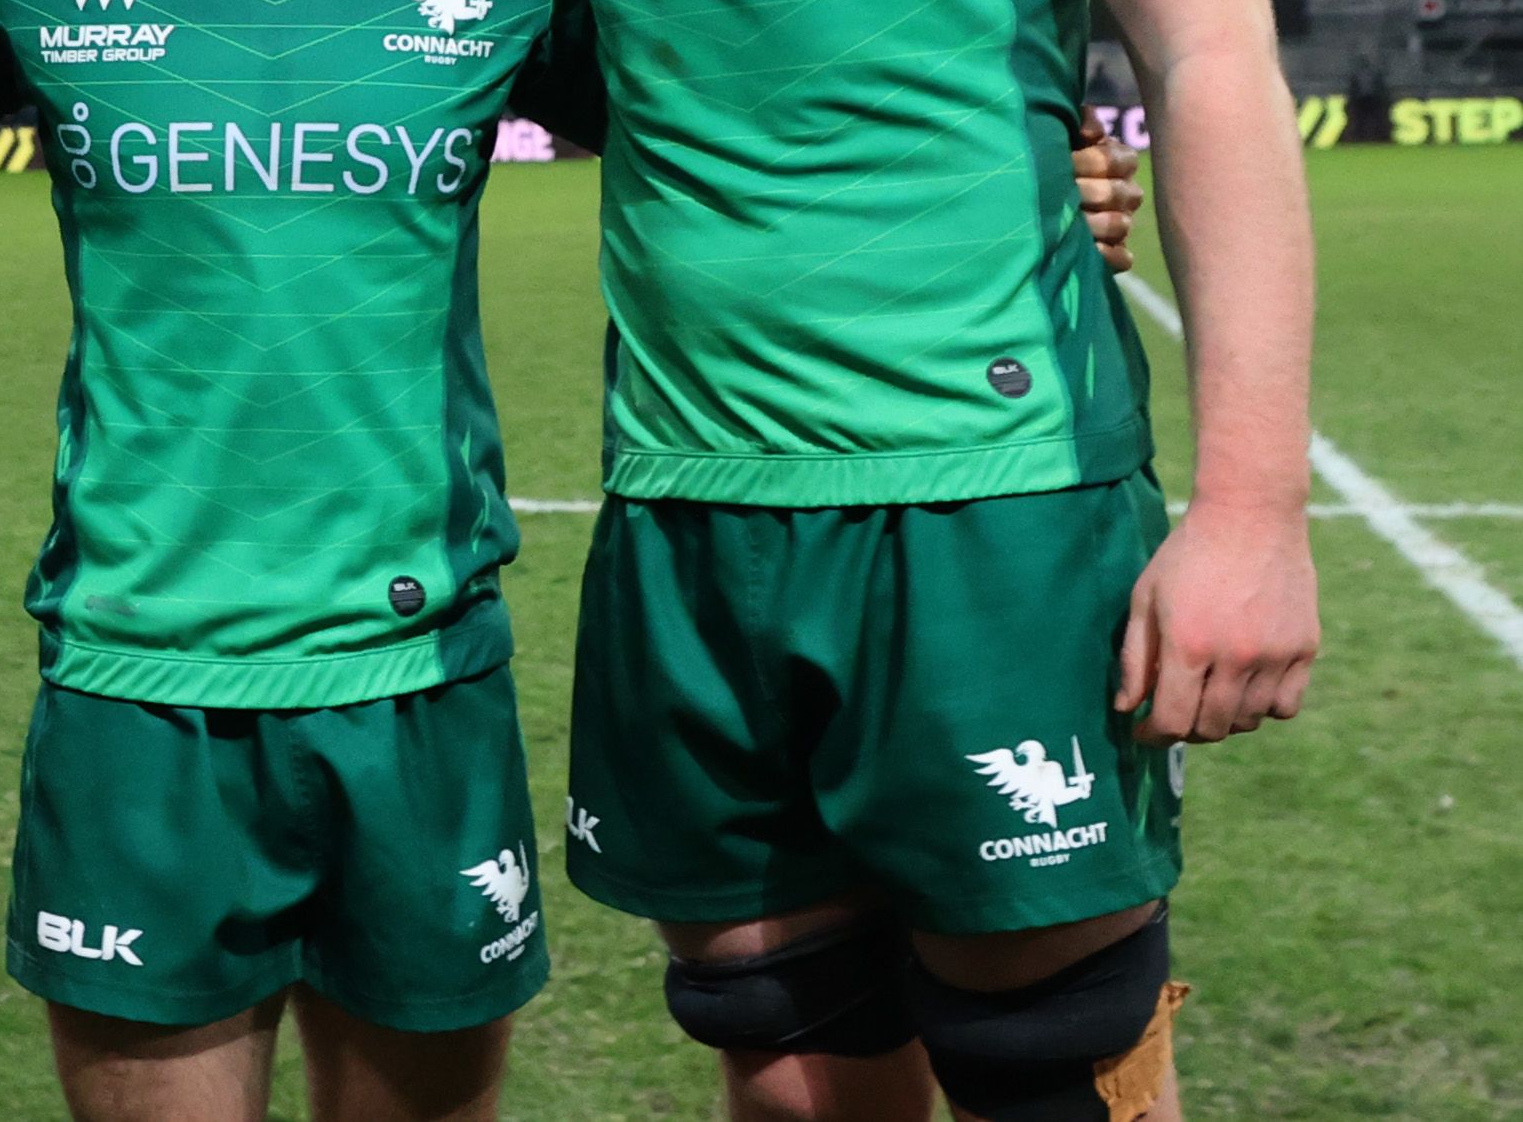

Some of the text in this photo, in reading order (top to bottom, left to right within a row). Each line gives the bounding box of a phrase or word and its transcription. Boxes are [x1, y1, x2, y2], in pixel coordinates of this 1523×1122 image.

[40, 24, 175, 48] MURRAY
[383, 33, 494, 58] CONNACHT
[40, 48, 166, 64] TIMBER GROUP
[424, 54, 457, 66] RUGBY
[1389, 96, 1523, 146] STEP
[110, 122, 473, 195] GENESYS
[566, 796, 603, 854] LK
[979, 821, 1108, 861] CONNACHT
[1029, 853, 1071, 867] RUGBY
[36, 909, 144, 967] BLK
